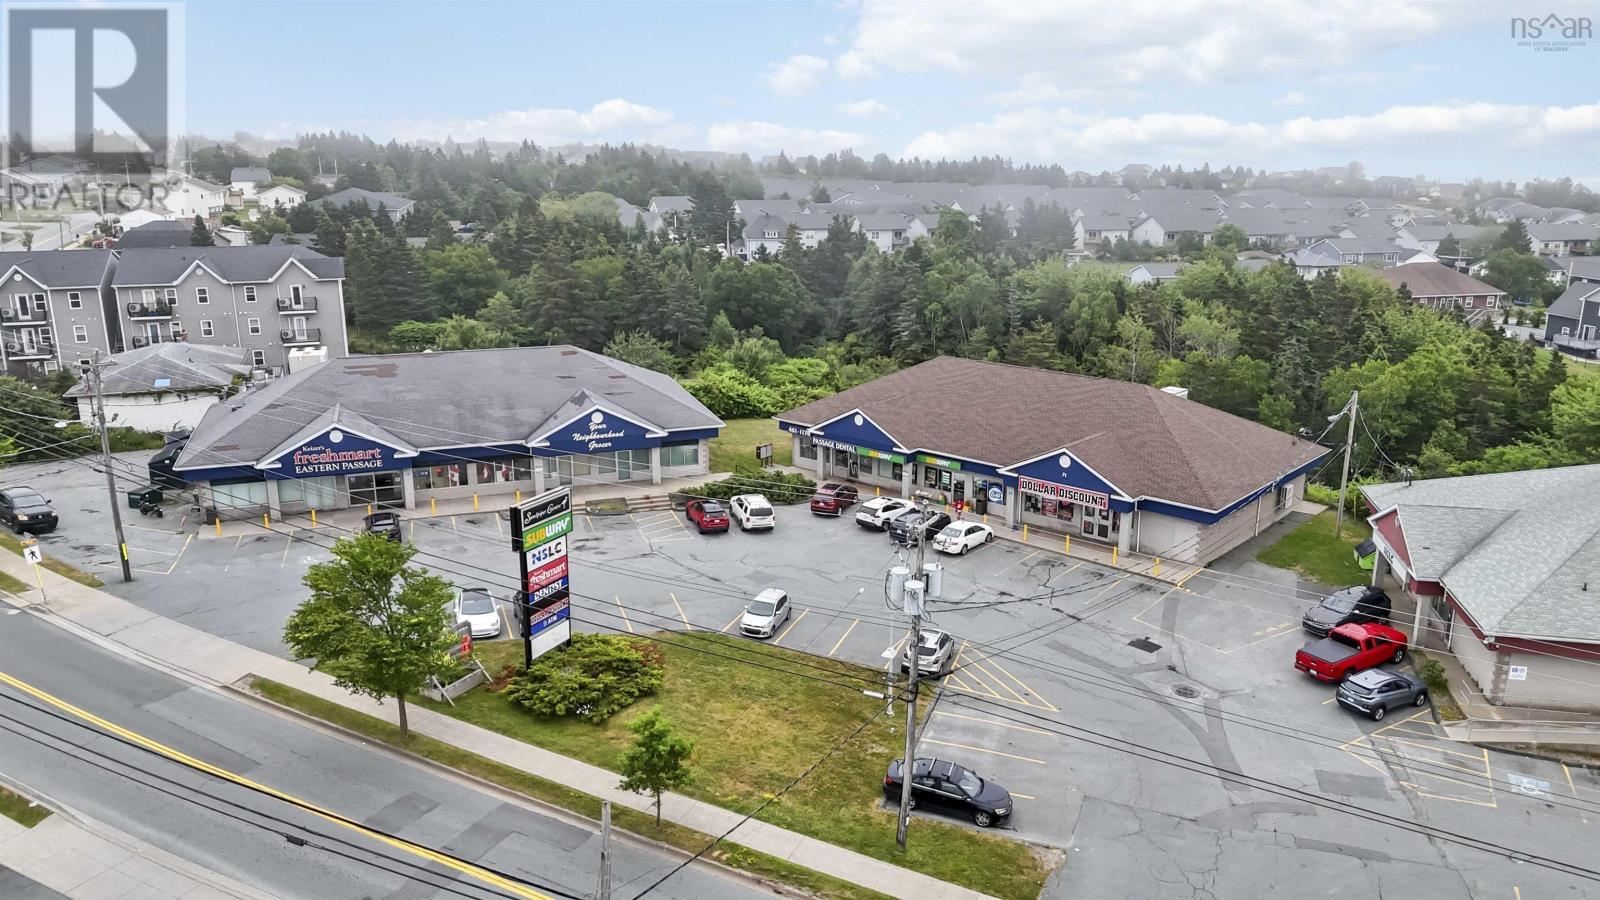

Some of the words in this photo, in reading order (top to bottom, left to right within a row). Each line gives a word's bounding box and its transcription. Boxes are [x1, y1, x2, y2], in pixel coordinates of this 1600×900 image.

[588, 422, 607, 431] Your
[572, 430, 625, 442] Neighbourhood
[812, 437, 835, 449] PASSAGE
[836, 442, 856, 453] DENTAL
[588, 441, 613, 451] Grocer
[293, 447, 382, 465] freshmart
[295, 462, 340, 474] EASTERN
[342, 459, 383, 470] PASSAGE
[1022, 480, 1056, 495] DOLLAR
[1059, 488, 1104, 507] DISCOUNT
[527, 517, 570, 545] SUBWAY
[531, 541, 562, 565] NSLC
[530, 562, 567, 585] freshmart
[534, 579, 563, 601] DENTIST
